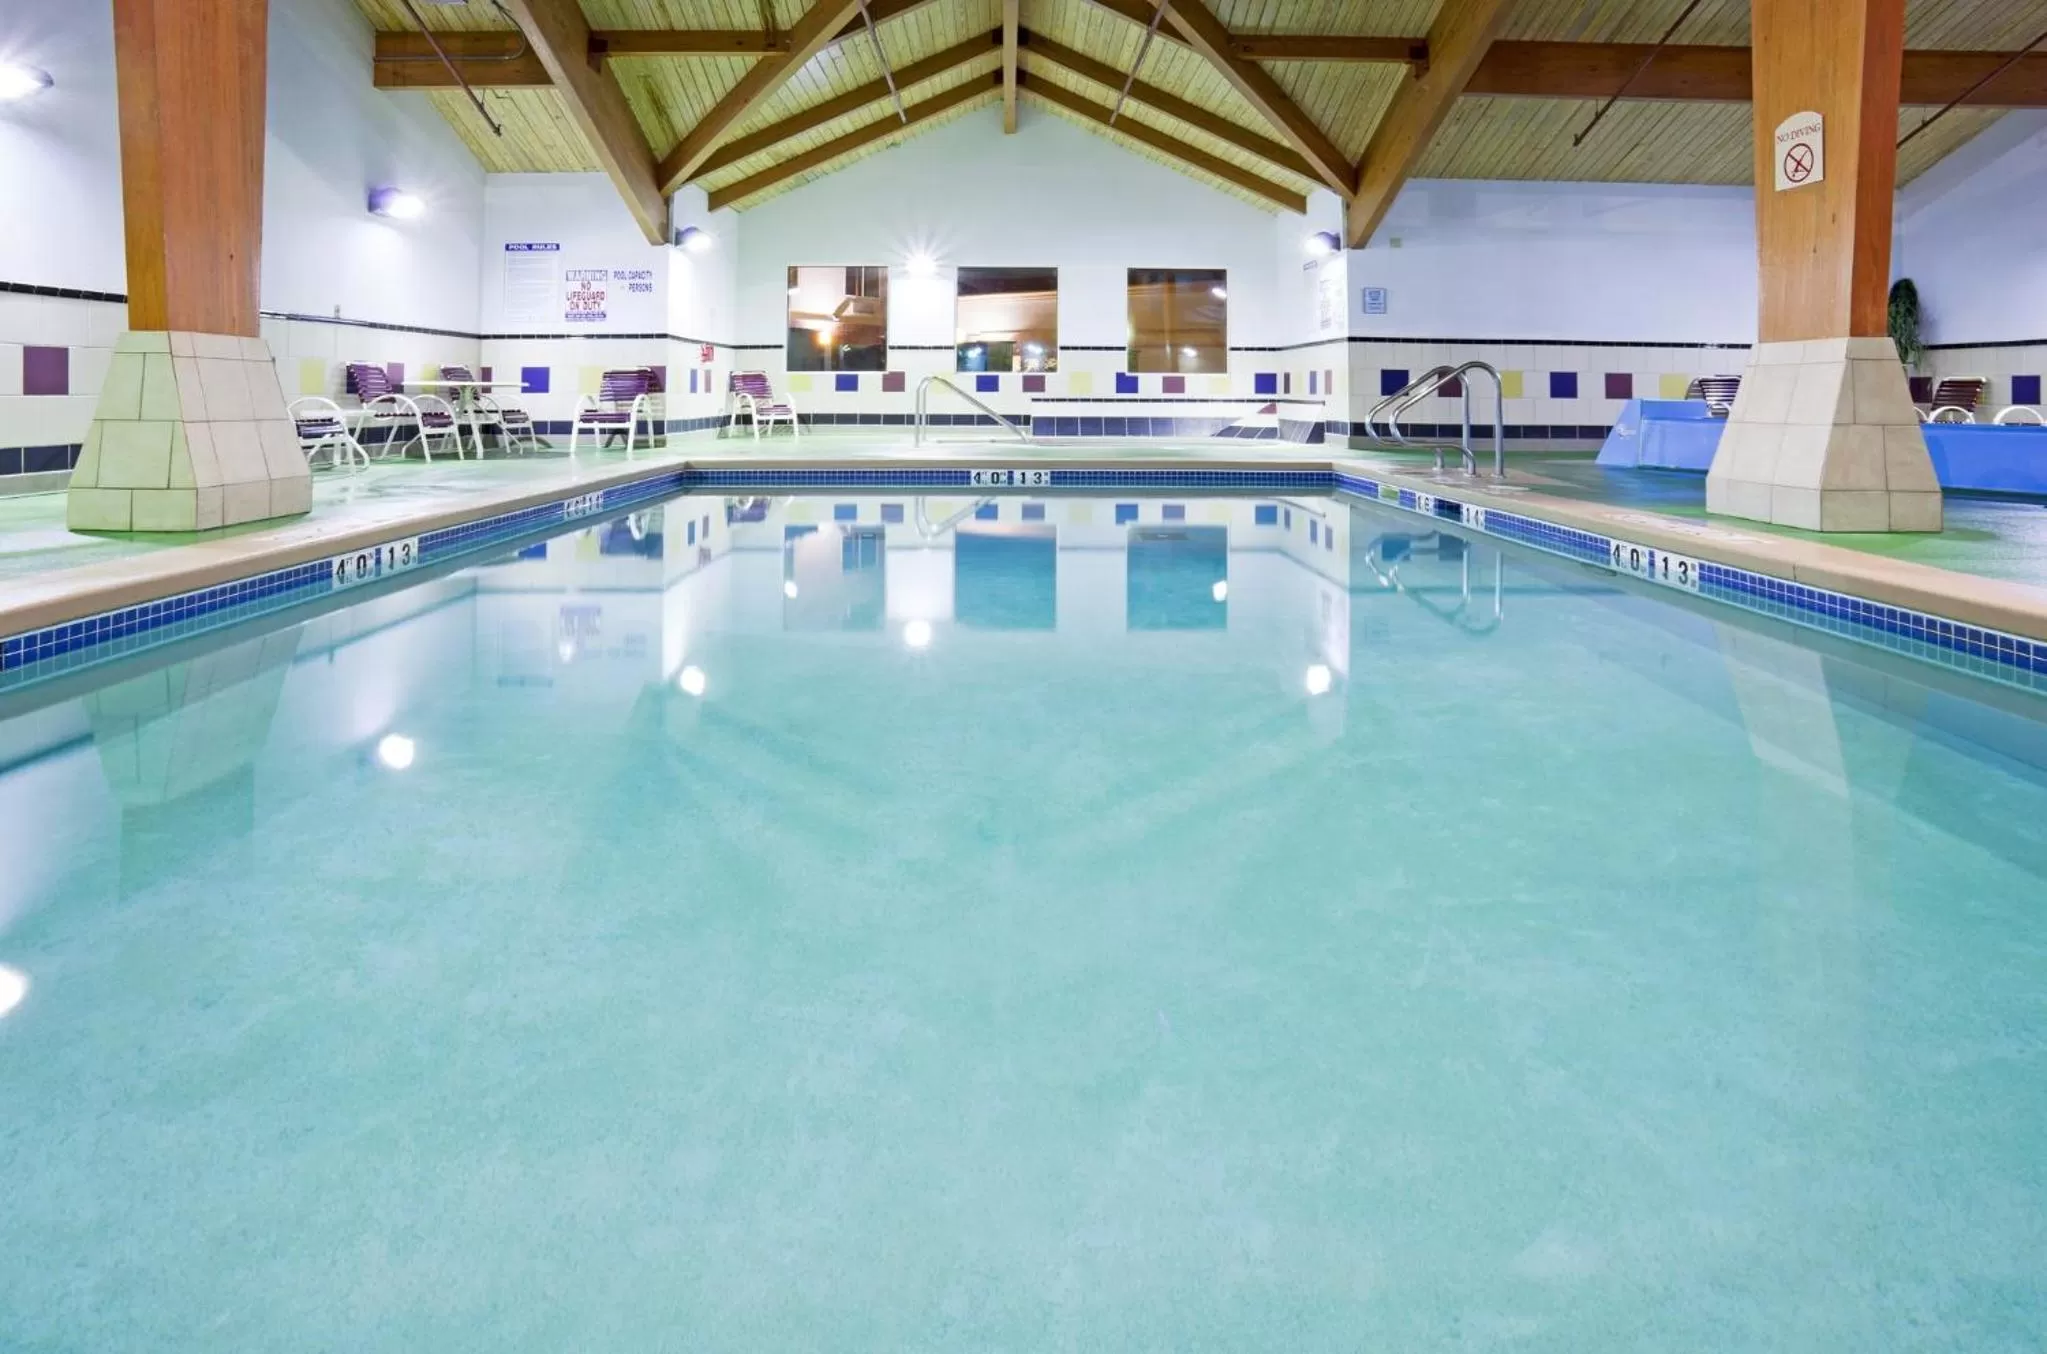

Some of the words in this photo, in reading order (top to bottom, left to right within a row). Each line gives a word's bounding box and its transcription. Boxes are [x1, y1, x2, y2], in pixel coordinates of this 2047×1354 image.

[1777, 133, 1789, 142] NO
[1791, 123, 1821, 139] DIVING
[614, 270, 627, 280] POOL
[628, 270, 653, 280] CAPACITY
[581, 281, 591, 290] NO
[629, 283, 652, 292] PERSONS
[567, 291, 605, 301] LIFEGUARD
[570, 301, 580, 310] ON
[583, 301, 600, 310] DUTY
